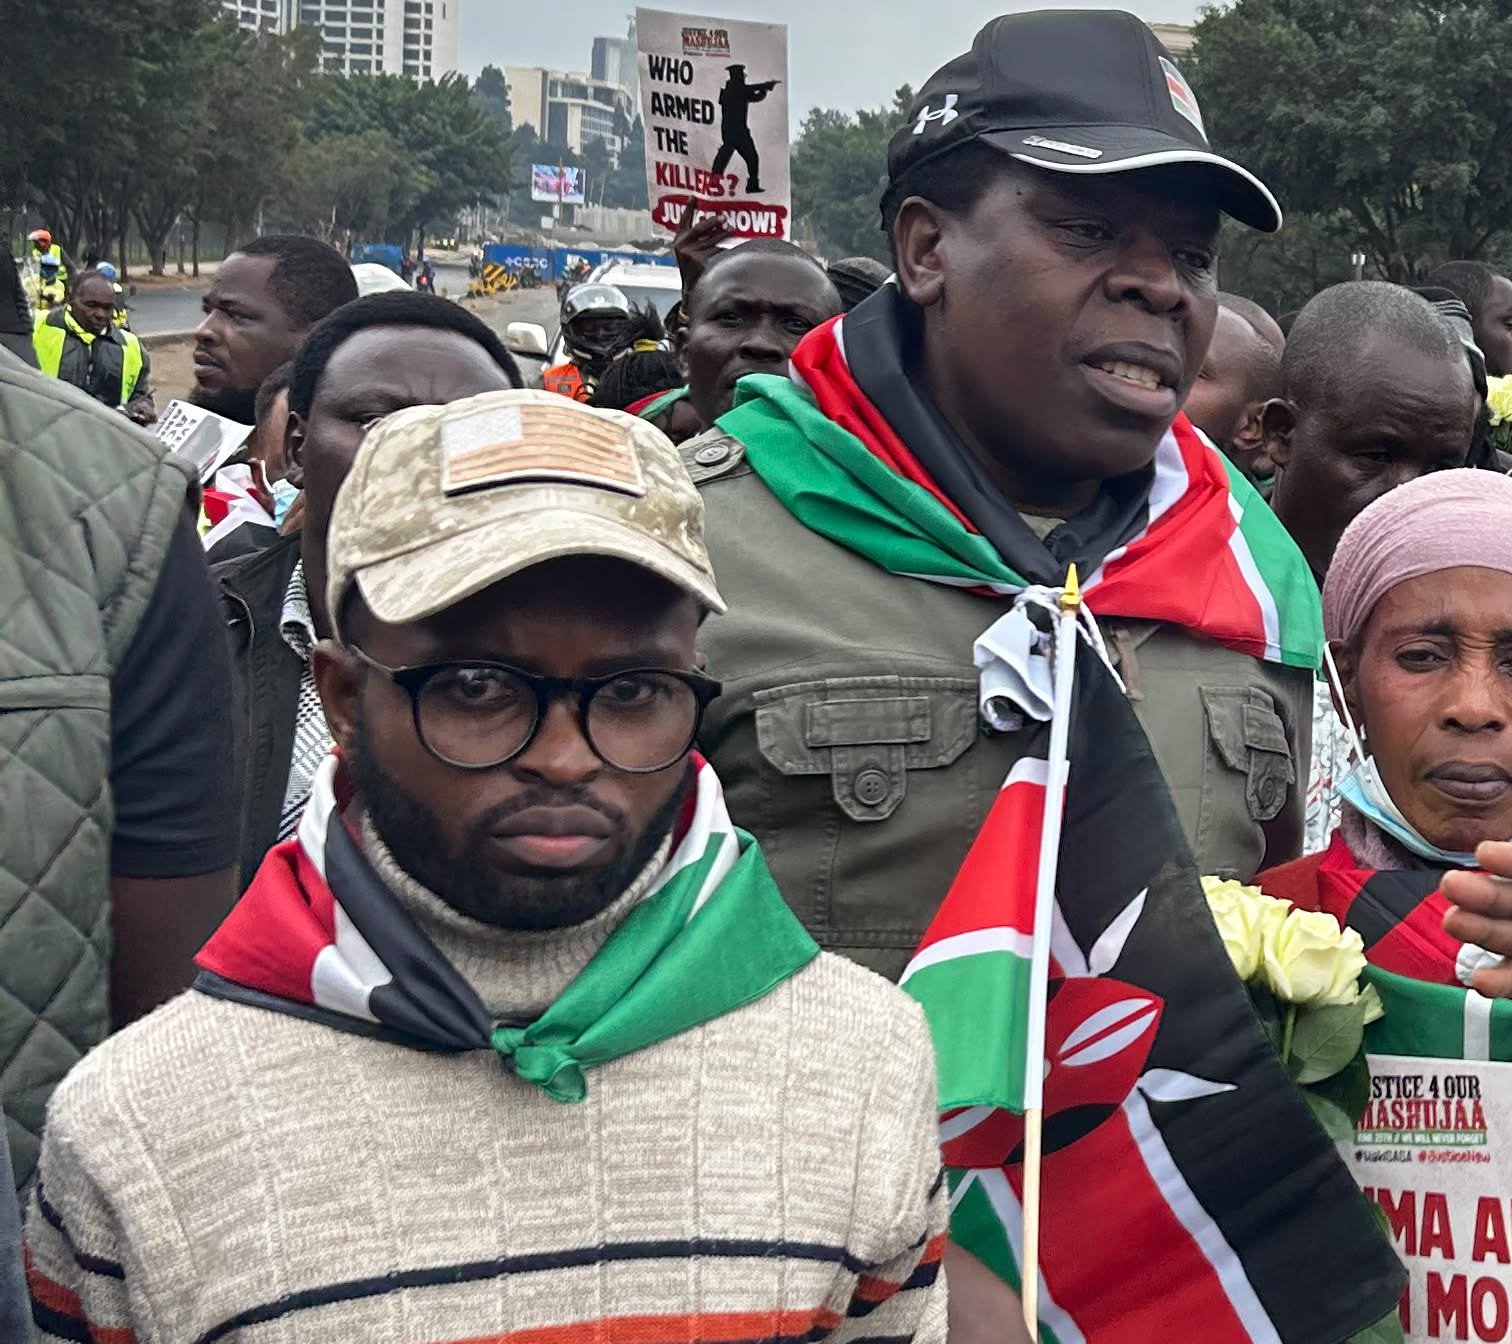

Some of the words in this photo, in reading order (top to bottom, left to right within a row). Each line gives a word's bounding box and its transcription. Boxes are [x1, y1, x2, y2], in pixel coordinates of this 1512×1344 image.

[648, 55, 693, 85] WHO
[650, 92, 715, 125] ARMED
[653, 127, 689, 156] THE
[656, 161, 739, 197] KILLERS?
[1371, 1075, 1424, 1099] STICE
[1429, 1075, 1439, 1099] 4
[1444, 1075, 1481, 1099] OUR
